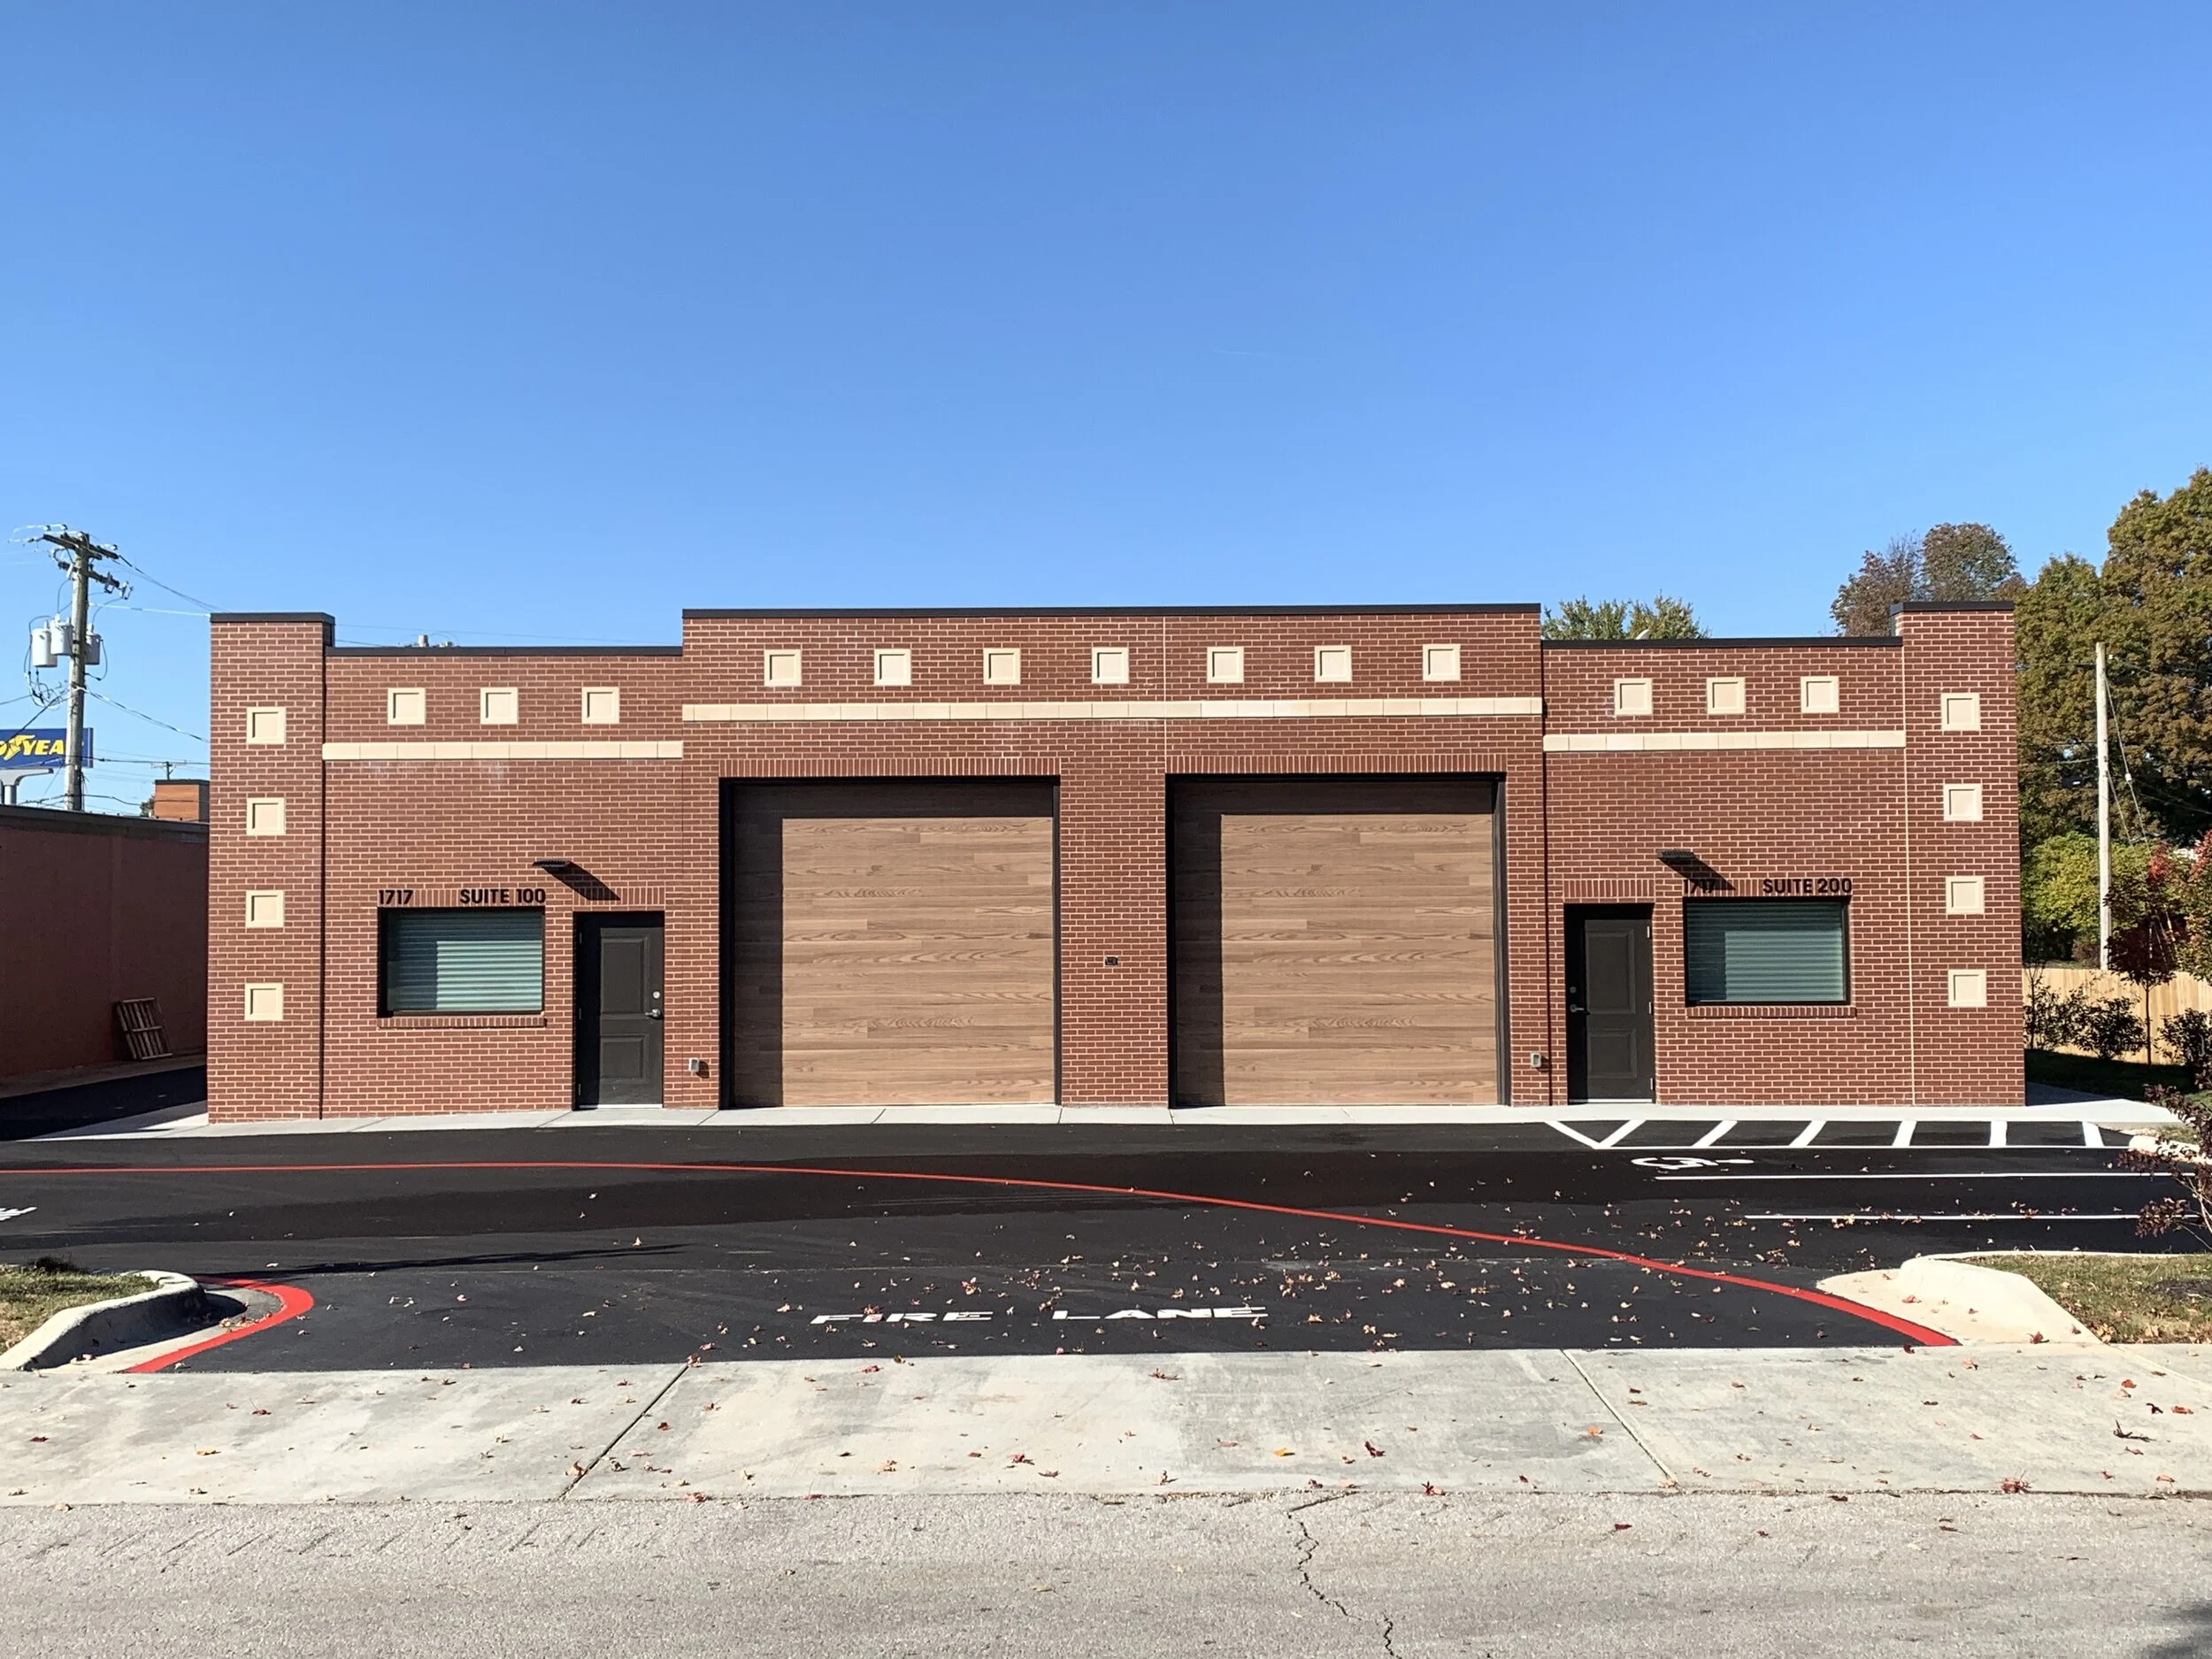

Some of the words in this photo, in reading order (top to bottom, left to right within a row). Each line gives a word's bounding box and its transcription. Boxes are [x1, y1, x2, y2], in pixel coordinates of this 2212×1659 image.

[1763, 879, 1813, 894] SUITE
[1817, 878, 1852, 893] 200
[379, 889, 413, 904] 1717
[460, 888, 509, 903] SUITE
[517, 888, 546, 903] 100
[810, 1311, 994, 1324] FIRE
[1052, 1307, 1269, 1319] LANE
